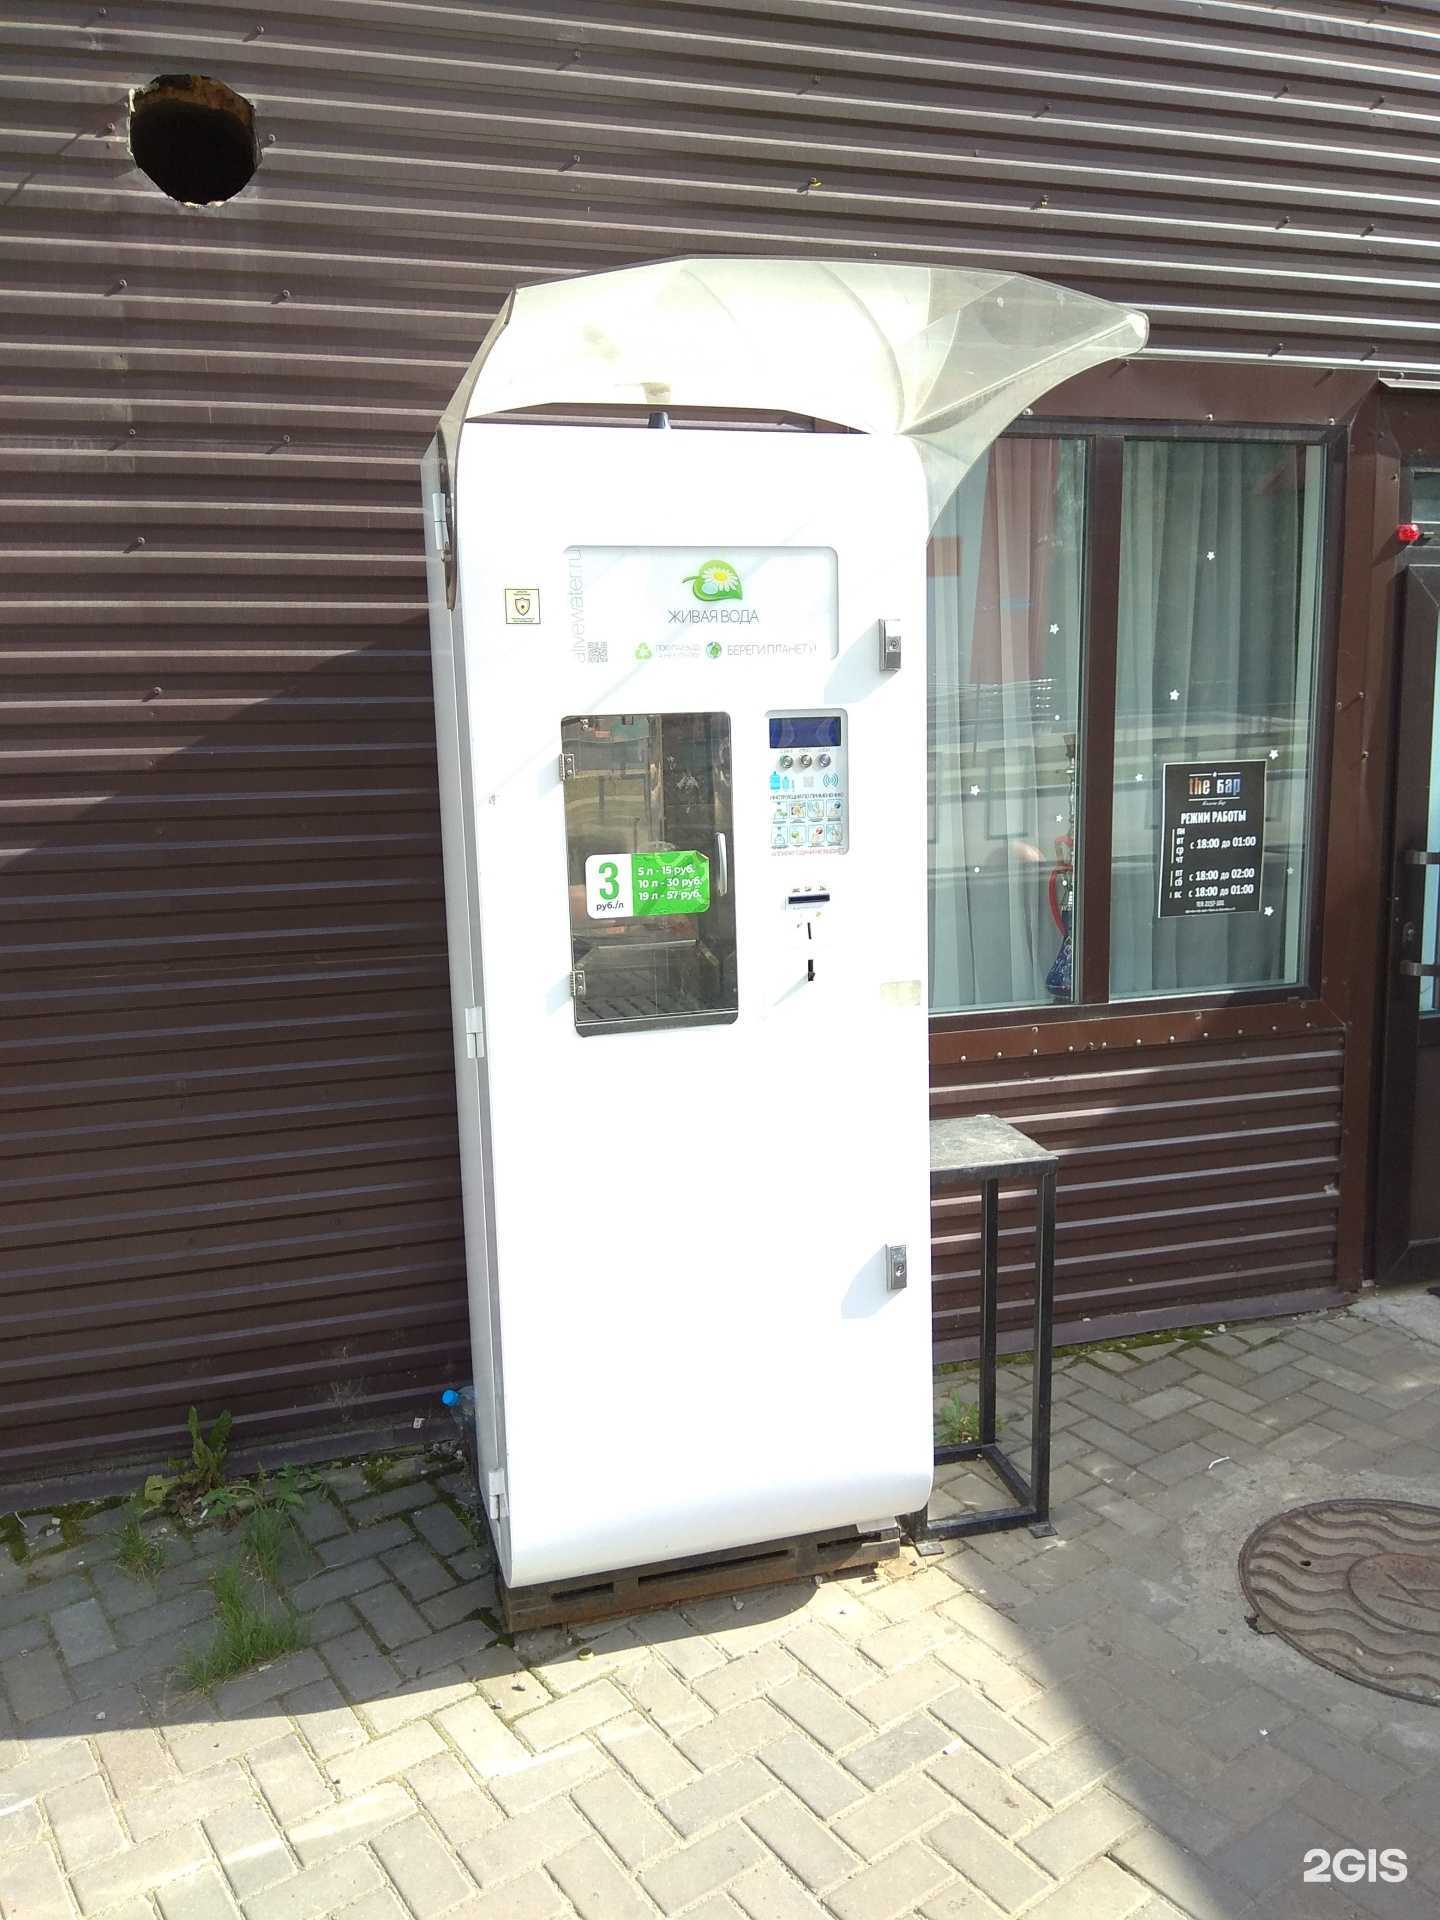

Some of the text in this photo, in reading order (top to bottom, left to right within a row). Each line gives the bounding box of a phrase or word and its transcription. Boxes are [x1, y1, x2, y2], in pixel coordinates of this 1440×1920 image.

[568, 546, 587, 664] alivewater.ru
[667, 608, 760, 625] ЖИВАЯ ВОДА
[1189, 777, 1211, 796] the
[1180, 809, 1247, 825] РЕЖИМ РАБОТЫ
[1196, 838, 1221, 849] 18:00
[1221, 841, 1231, 849] до
[1232, 836, 1256, 847] 01:00
[638, 867, 645, 876] 5
[662, 866, 673, 875] 15
[675, 864, 696, 875] руб.
[1195, 869, 1219, 881] 18:00
[1220, 872, 1230, 880] до
[1231, 867, 1255, 878] 02:00
[598, 862, 619, 900] 3
[639, 880, 650, 889] 10
[667, 878, 680, 887] 30
[683, 876, 703, 887] руб.
[640, 892, 650, 901] 19
[668, 891, 680, 900] 57
[682, 889, 702, 900] руб.
[1194, 886, 1219, 897] 18:00
[1219, 888, 1229, 897] до
[1230, 884, 1255, 895] 01:00
[596, 901, 624, 911] руб./л
